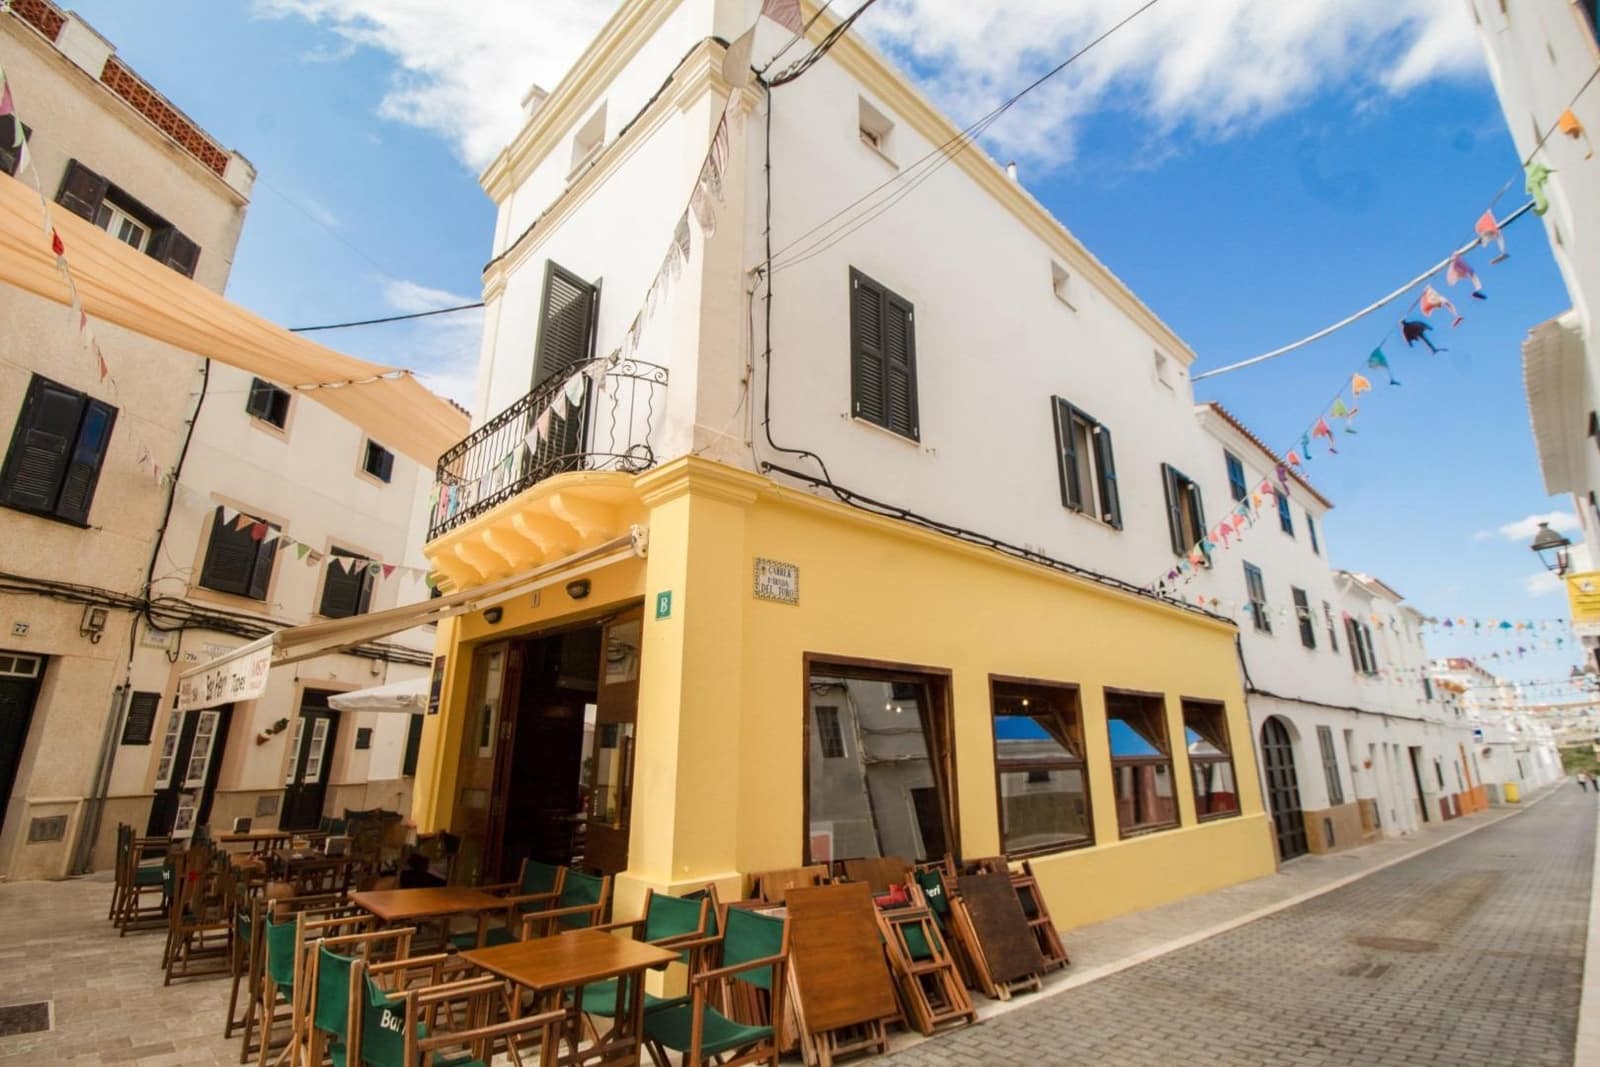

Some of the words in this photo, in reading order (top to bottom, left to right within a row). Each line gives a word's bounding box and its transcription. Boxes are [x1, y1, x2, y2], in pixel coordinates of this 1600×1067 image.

[760, 583, 773, 593] DEL
[660, 597, 668, 614] B
[15, 623, 30, 633] 77
[380, 1009, 403, 1033] Bar
